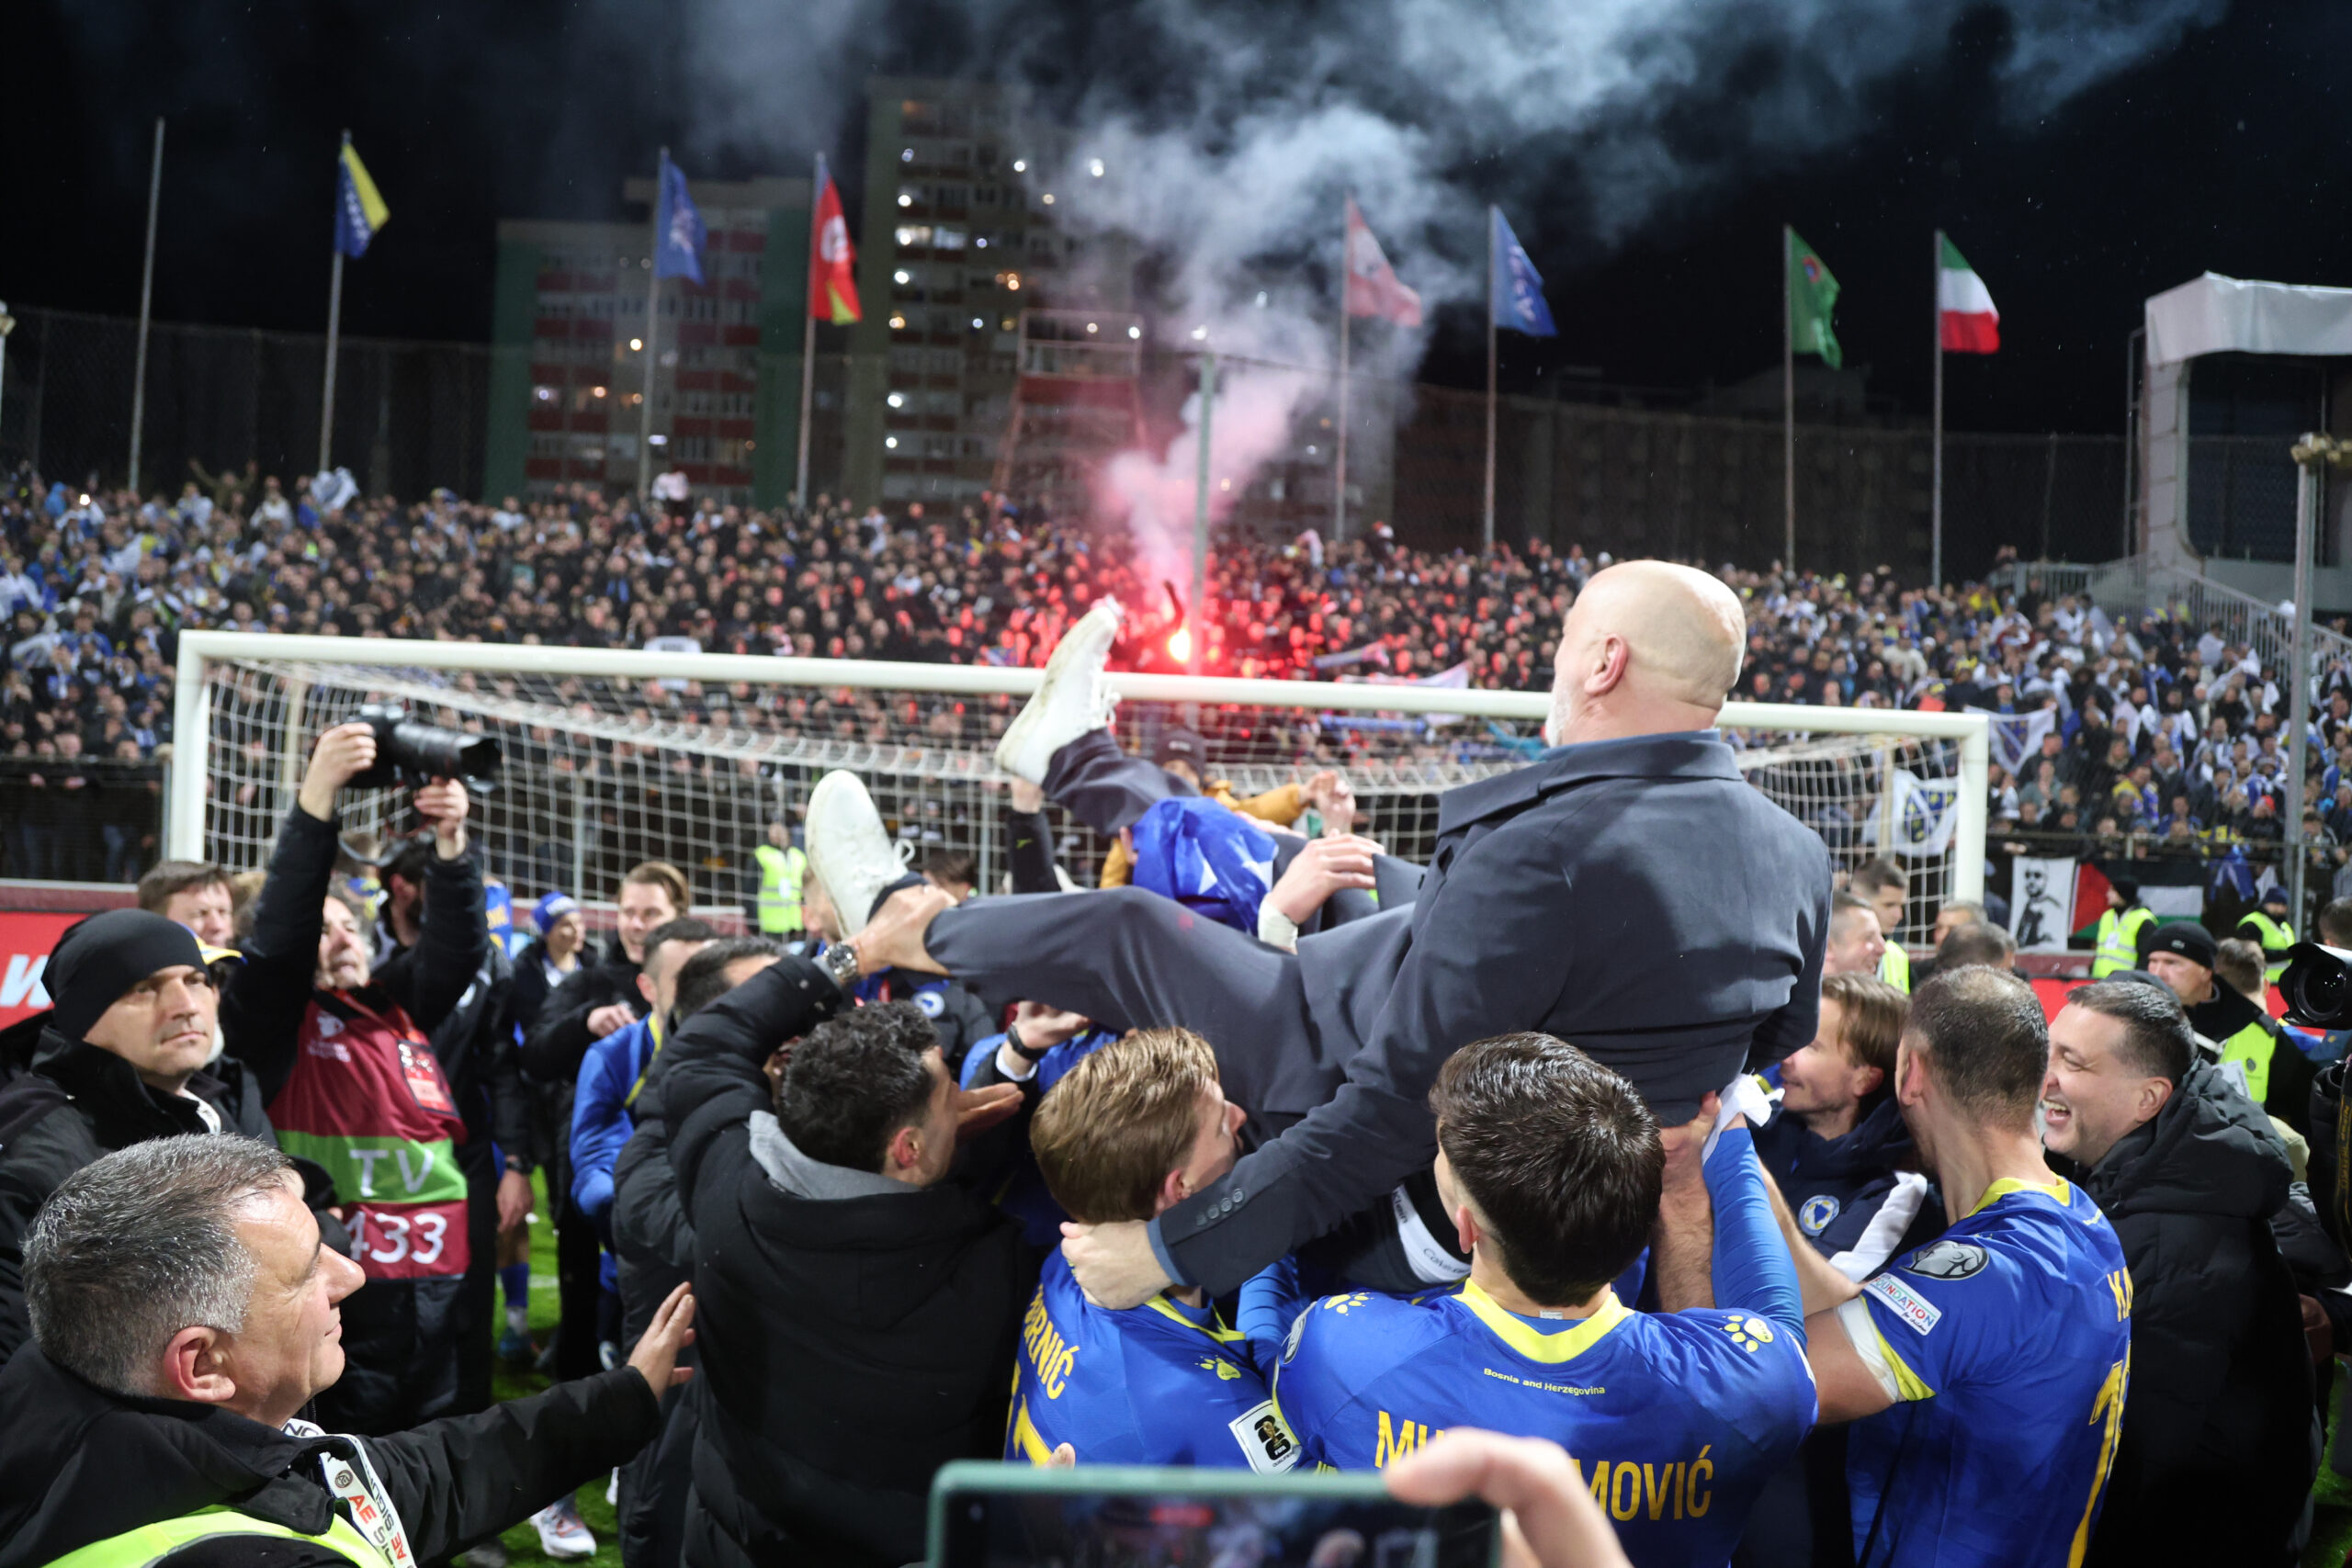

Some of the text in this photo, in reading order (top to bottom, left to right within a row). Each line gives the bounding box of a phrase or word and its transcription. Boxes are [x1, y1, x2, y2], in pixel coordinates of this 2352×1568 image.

[349, 1148, 435, 1197] TV
[345, 1211, 447, 1264] 433
[1874, 1277, 1934, 1326] FOUNDATION
[1484, 1368, 1606, 1396] Bosnia and Herzegovina
[348, 1495, 378, 1525] AE
[390, 1532, 407, 1561] AE
